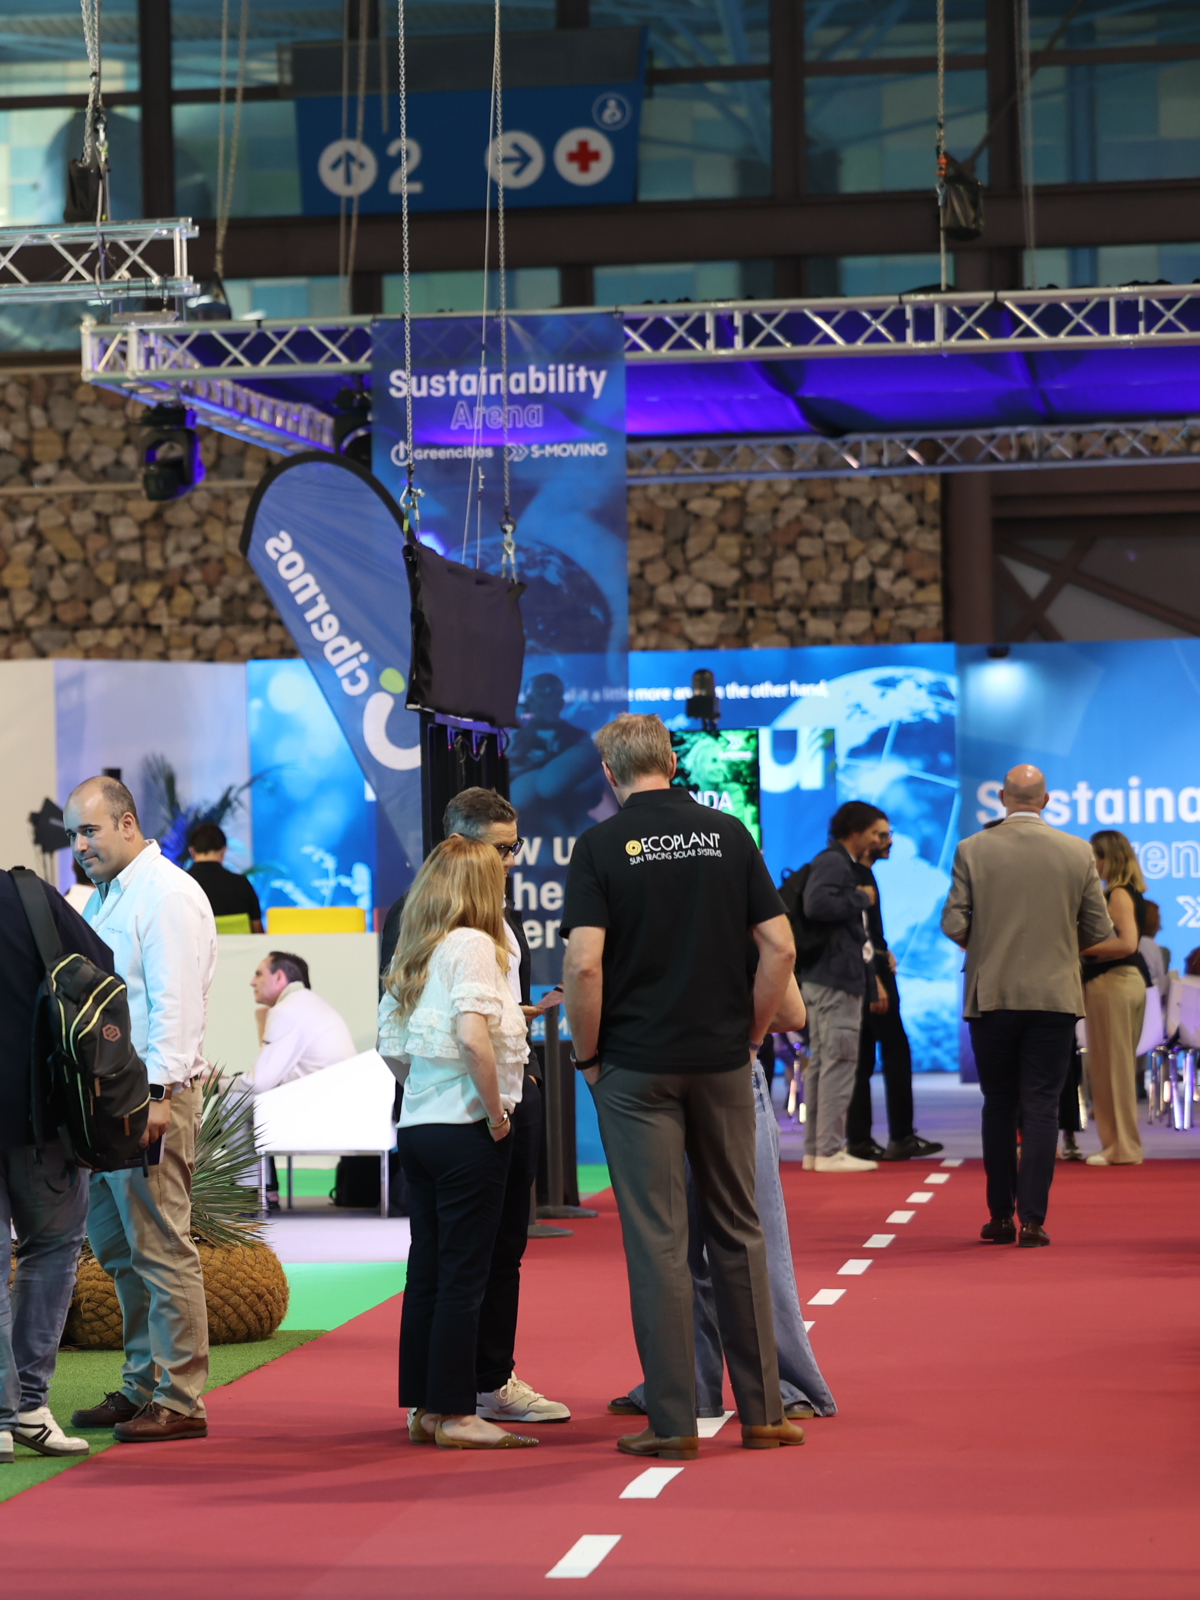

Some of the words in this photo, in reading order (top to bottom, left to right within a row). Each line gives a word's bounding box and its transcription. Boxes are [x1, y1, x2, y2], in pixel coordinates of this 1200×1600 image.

[386, 138, 423, 194] 2
[389, 364, 607, 399] Sustainability
[450, 400, 544, 430] Arena
[530, 443, 608, 458] S-MOVING
[635, 686, 670, 701] more
[673, 686, 694, 701] an
[725, 681, 750, 699] the
[750, 680, 789, 698] other
[976, 776, 1200, 826] Sstaina
[629, 856, 644, 865] SUN
[645, 852, 672, 861] TRACING
[673, 849, 696, 859] SOLAR
[697, 847, 722, 857] SYSTEMS
[641, 831, 720, 853] ECOPLANT
[523, 918, 568, 949] er
